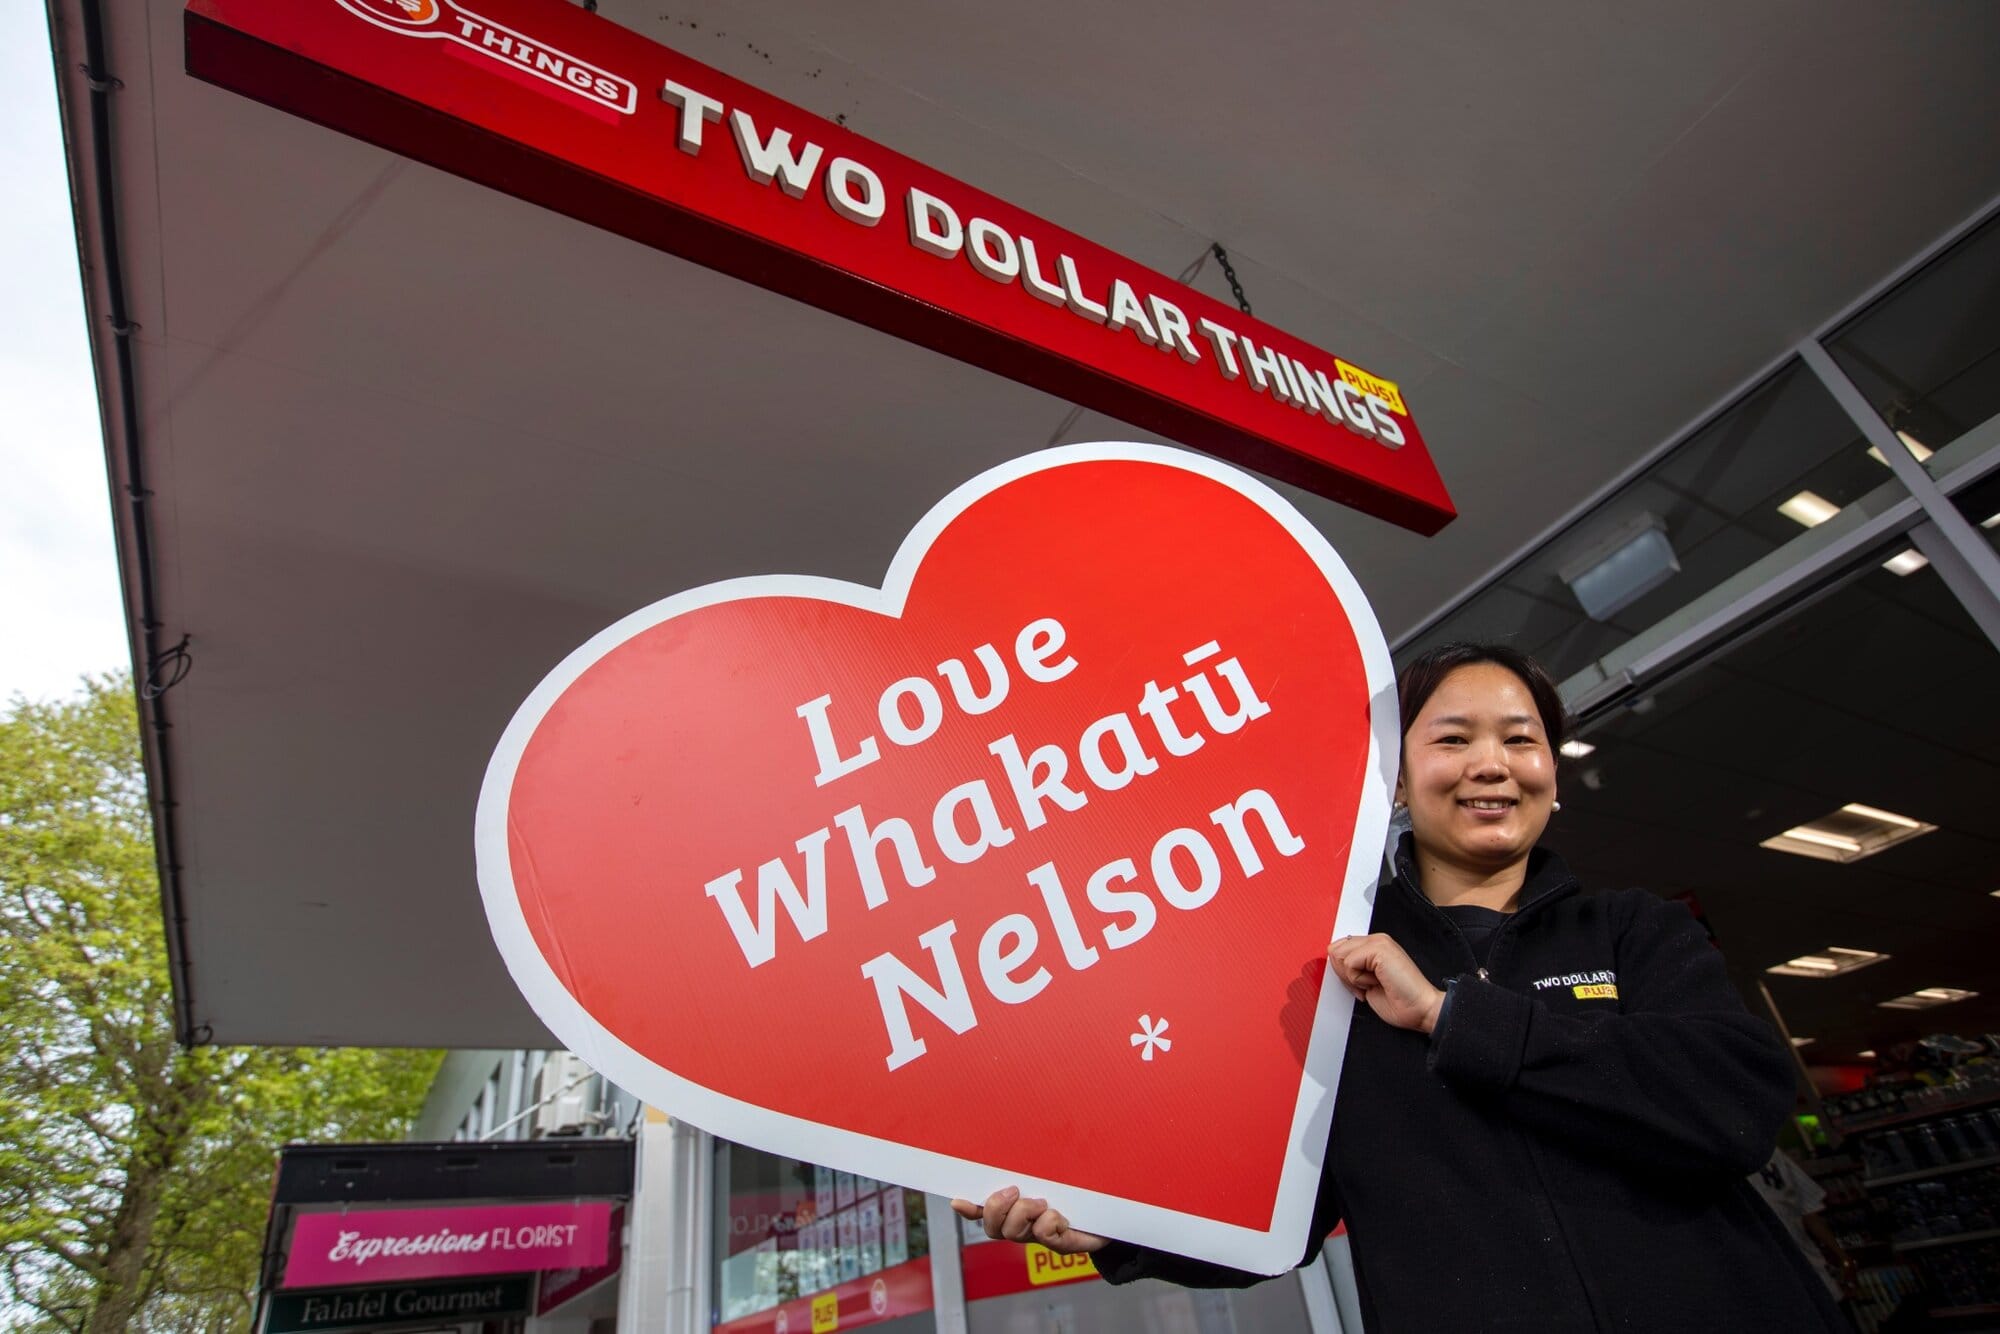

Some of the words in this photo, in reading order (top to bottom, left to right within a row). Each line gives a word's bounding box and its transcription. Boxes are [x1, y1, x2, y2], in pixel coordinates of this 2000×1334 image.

[455, 15, 620, 100] THINGS
[662, 78, 886, 227] TWO
[906, 186, 1202, 364] DOLLAR
[1199, 316, 1407, 450] THINGS
[1343, 369, 1399, 407] PLUS!
[795, 618, 1079, 788] Love
[703, 639, 1271, 969] Whakatū
[860, 788, 1306, 1072] Nelson
[1533, 977, 1561, 991] TWO
[1562, 970, 1609, 986] DOLLAR
[328, 1228, 488, 1266] Expressions
[491, 1224, 578, 1250] FLORIST
[301, 1291, 387, 1323] Falafel
[394, 1285, 504, 1315] Gourmet
